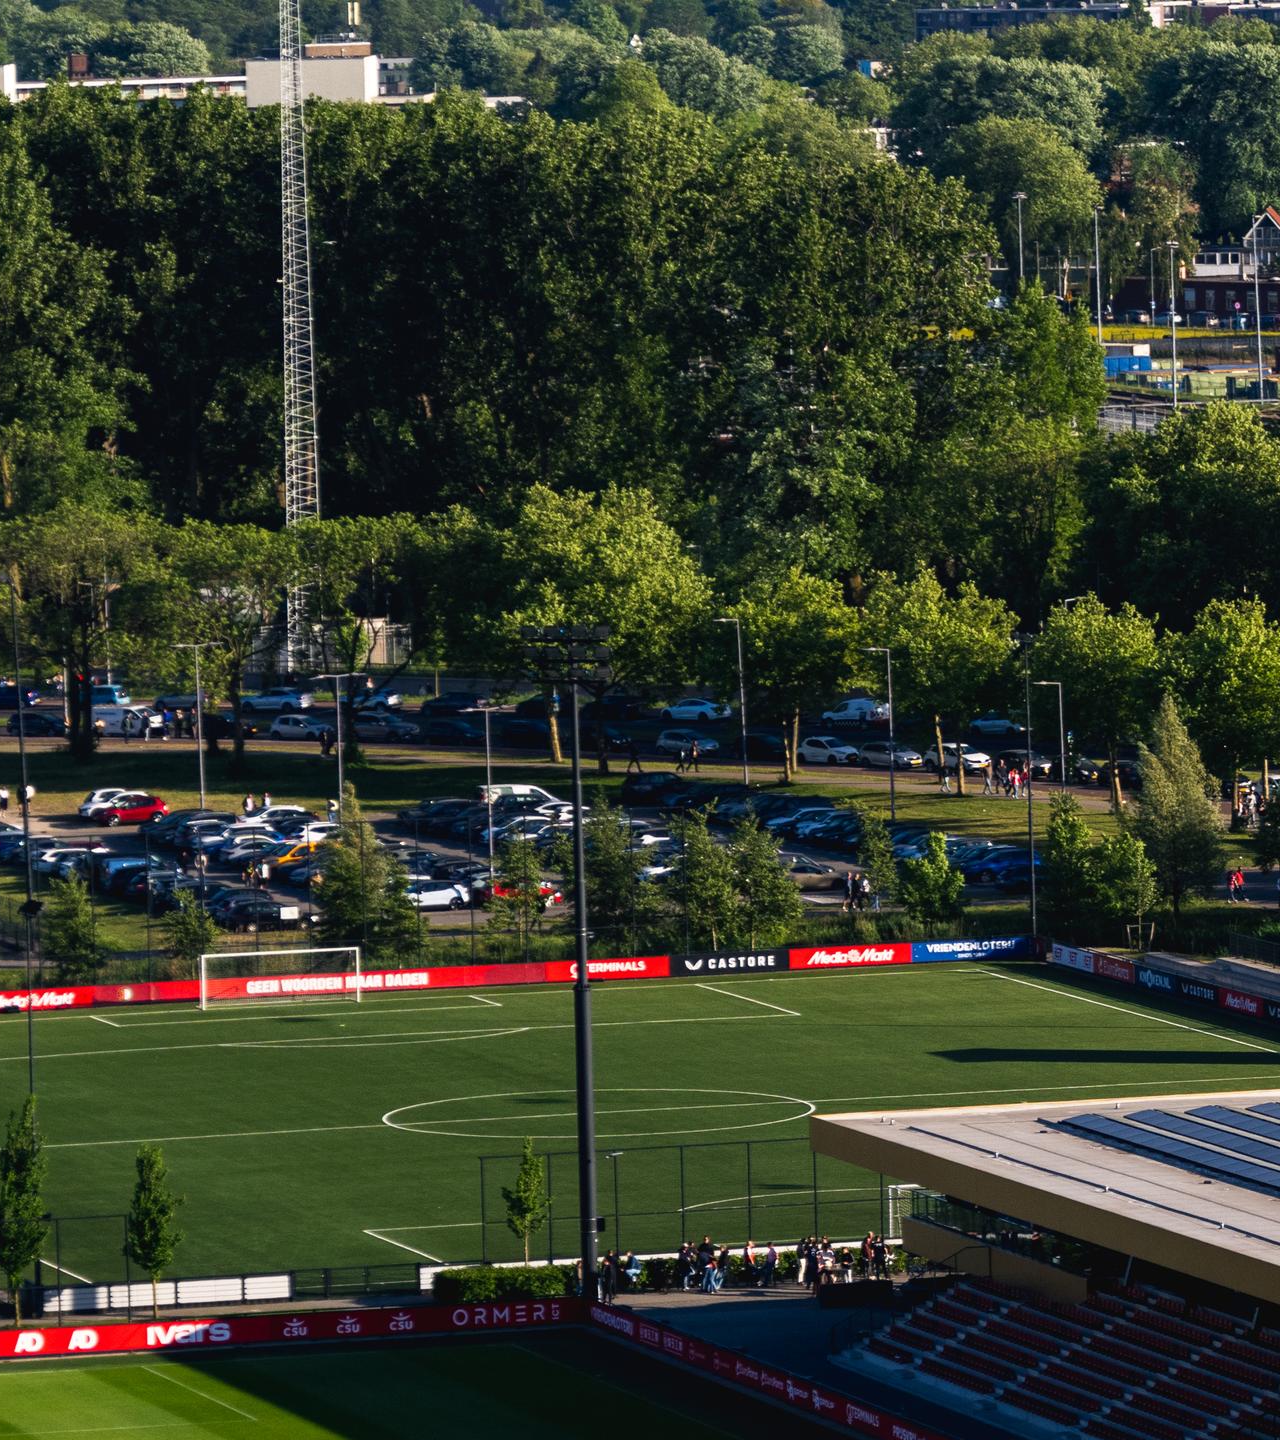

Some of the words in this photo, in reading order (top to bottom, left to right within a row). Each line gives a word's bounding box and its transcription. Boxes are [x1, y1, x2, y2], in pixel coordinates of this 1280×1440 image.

[708, 955, 775, 969] CASTORE
[247, 980, 278, 995] GEEN
[281, 976, 342, 993] WOORDEN
[345, 974, 381, 990] MAAR
[384, 972, 429, 987] DADEN
[452, 1304, 546, 1326] ORMER
[284, 1326, 308, 1337] CSU
[336, 1323, 361, 1334] CSU
[389, 1320, 413, 1331] CSU
[14, 1332, 45, 1354] AD
[68, 1329, 99, 1351] AD
